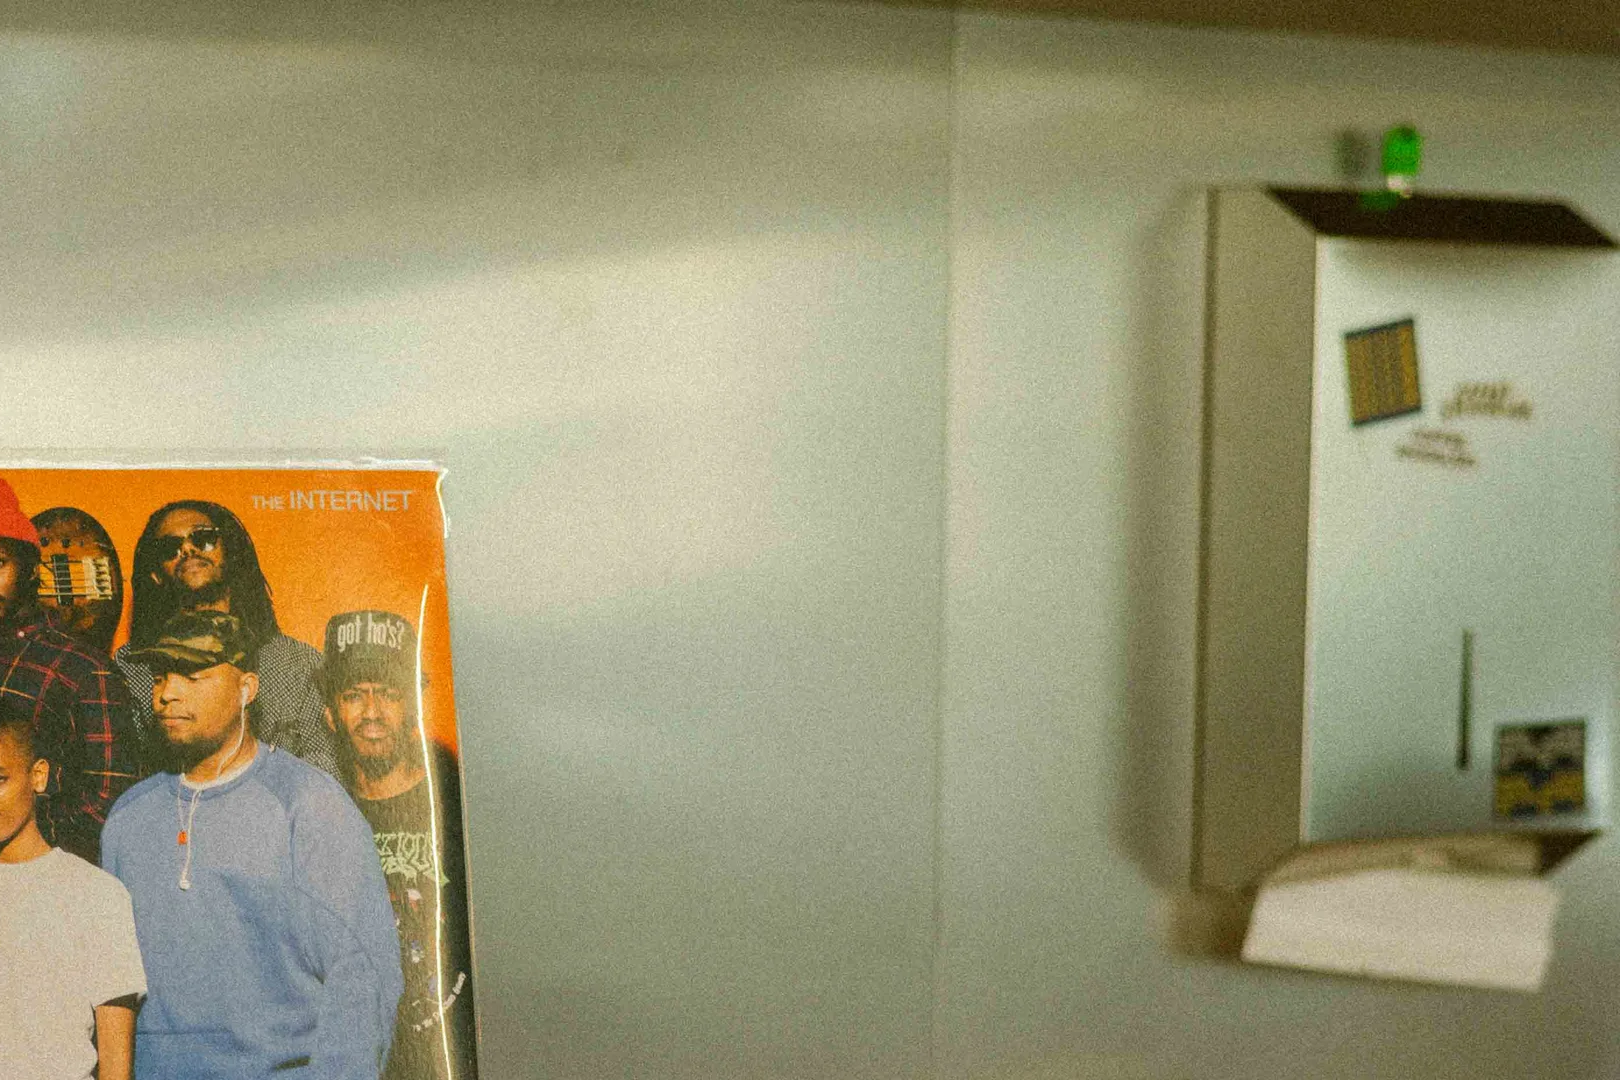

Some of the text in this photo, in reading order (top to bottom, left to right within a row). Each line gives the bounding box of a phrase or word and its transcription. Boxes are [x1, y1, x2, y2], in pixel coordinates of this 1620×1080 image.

[252, 489, 413, 512] THE INTERNET
[337, 612, 406, 653] got ho's?
